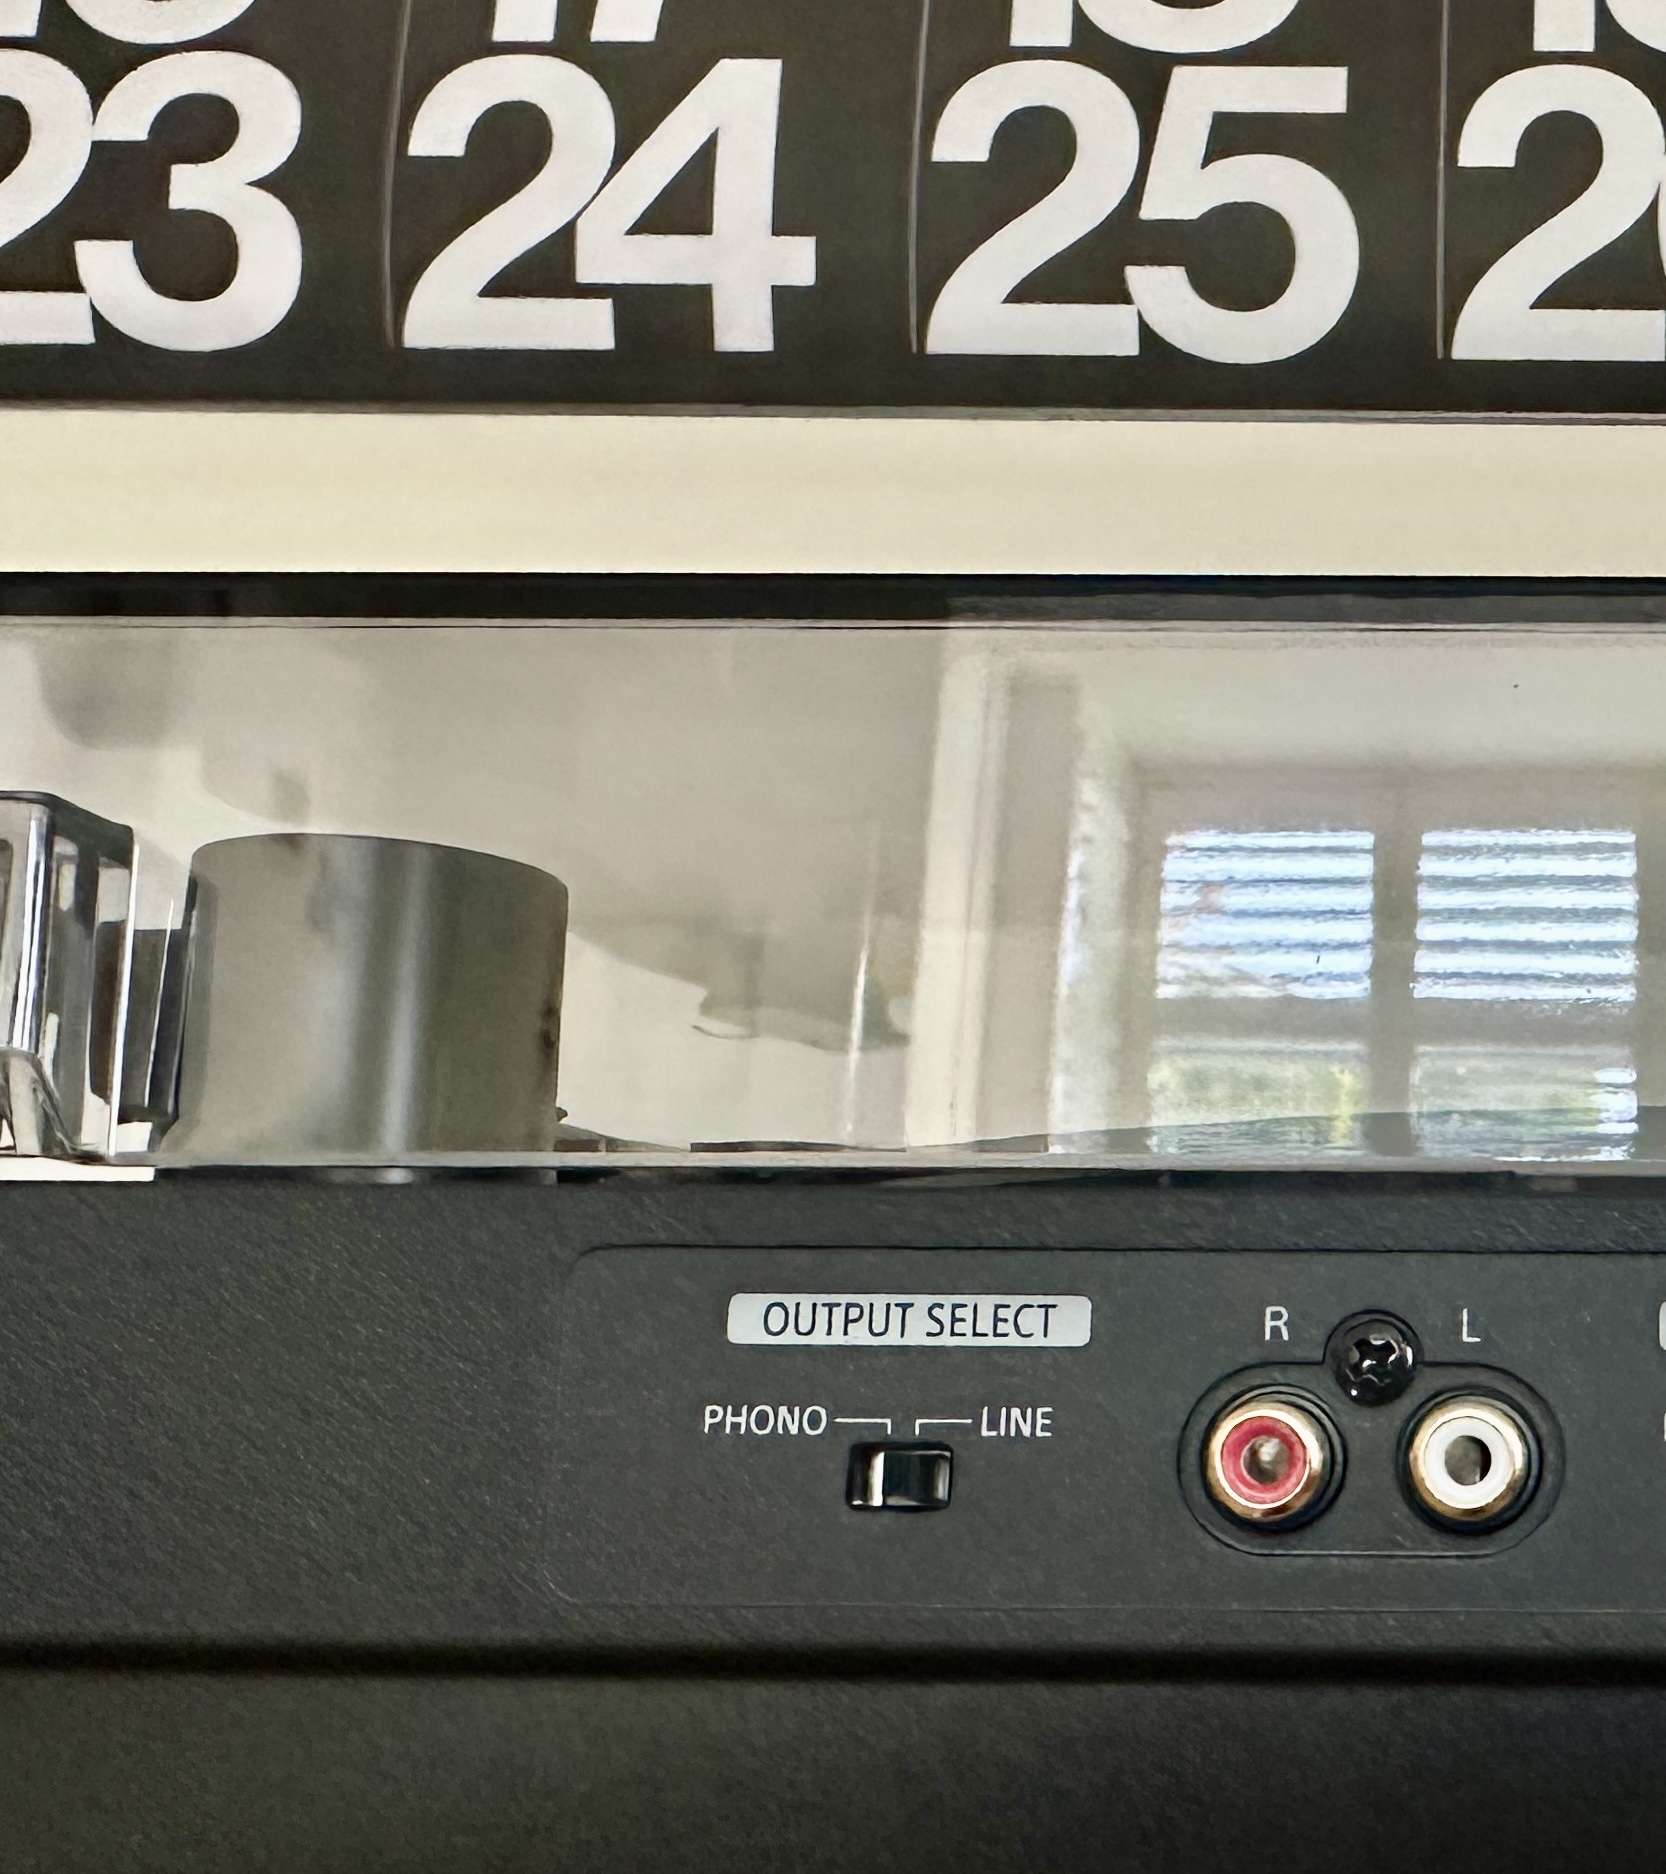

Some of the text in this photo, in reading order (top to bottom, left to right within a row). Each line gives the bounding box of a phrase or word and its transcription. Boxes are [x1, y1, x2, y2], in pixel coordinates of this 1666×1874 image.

[404, 54, 816, 352] 24
[926, 60, 1359, 364] 25
[763, 1302, 1058, 1339] OUTPUT SELECT
[1264, 1305, 1289, 1341] R
[1461, 1308, 1482, 1343] L
[703, 1404, 828, 1436] PHONO
[980, 1406, 1053, 1438] LINE
